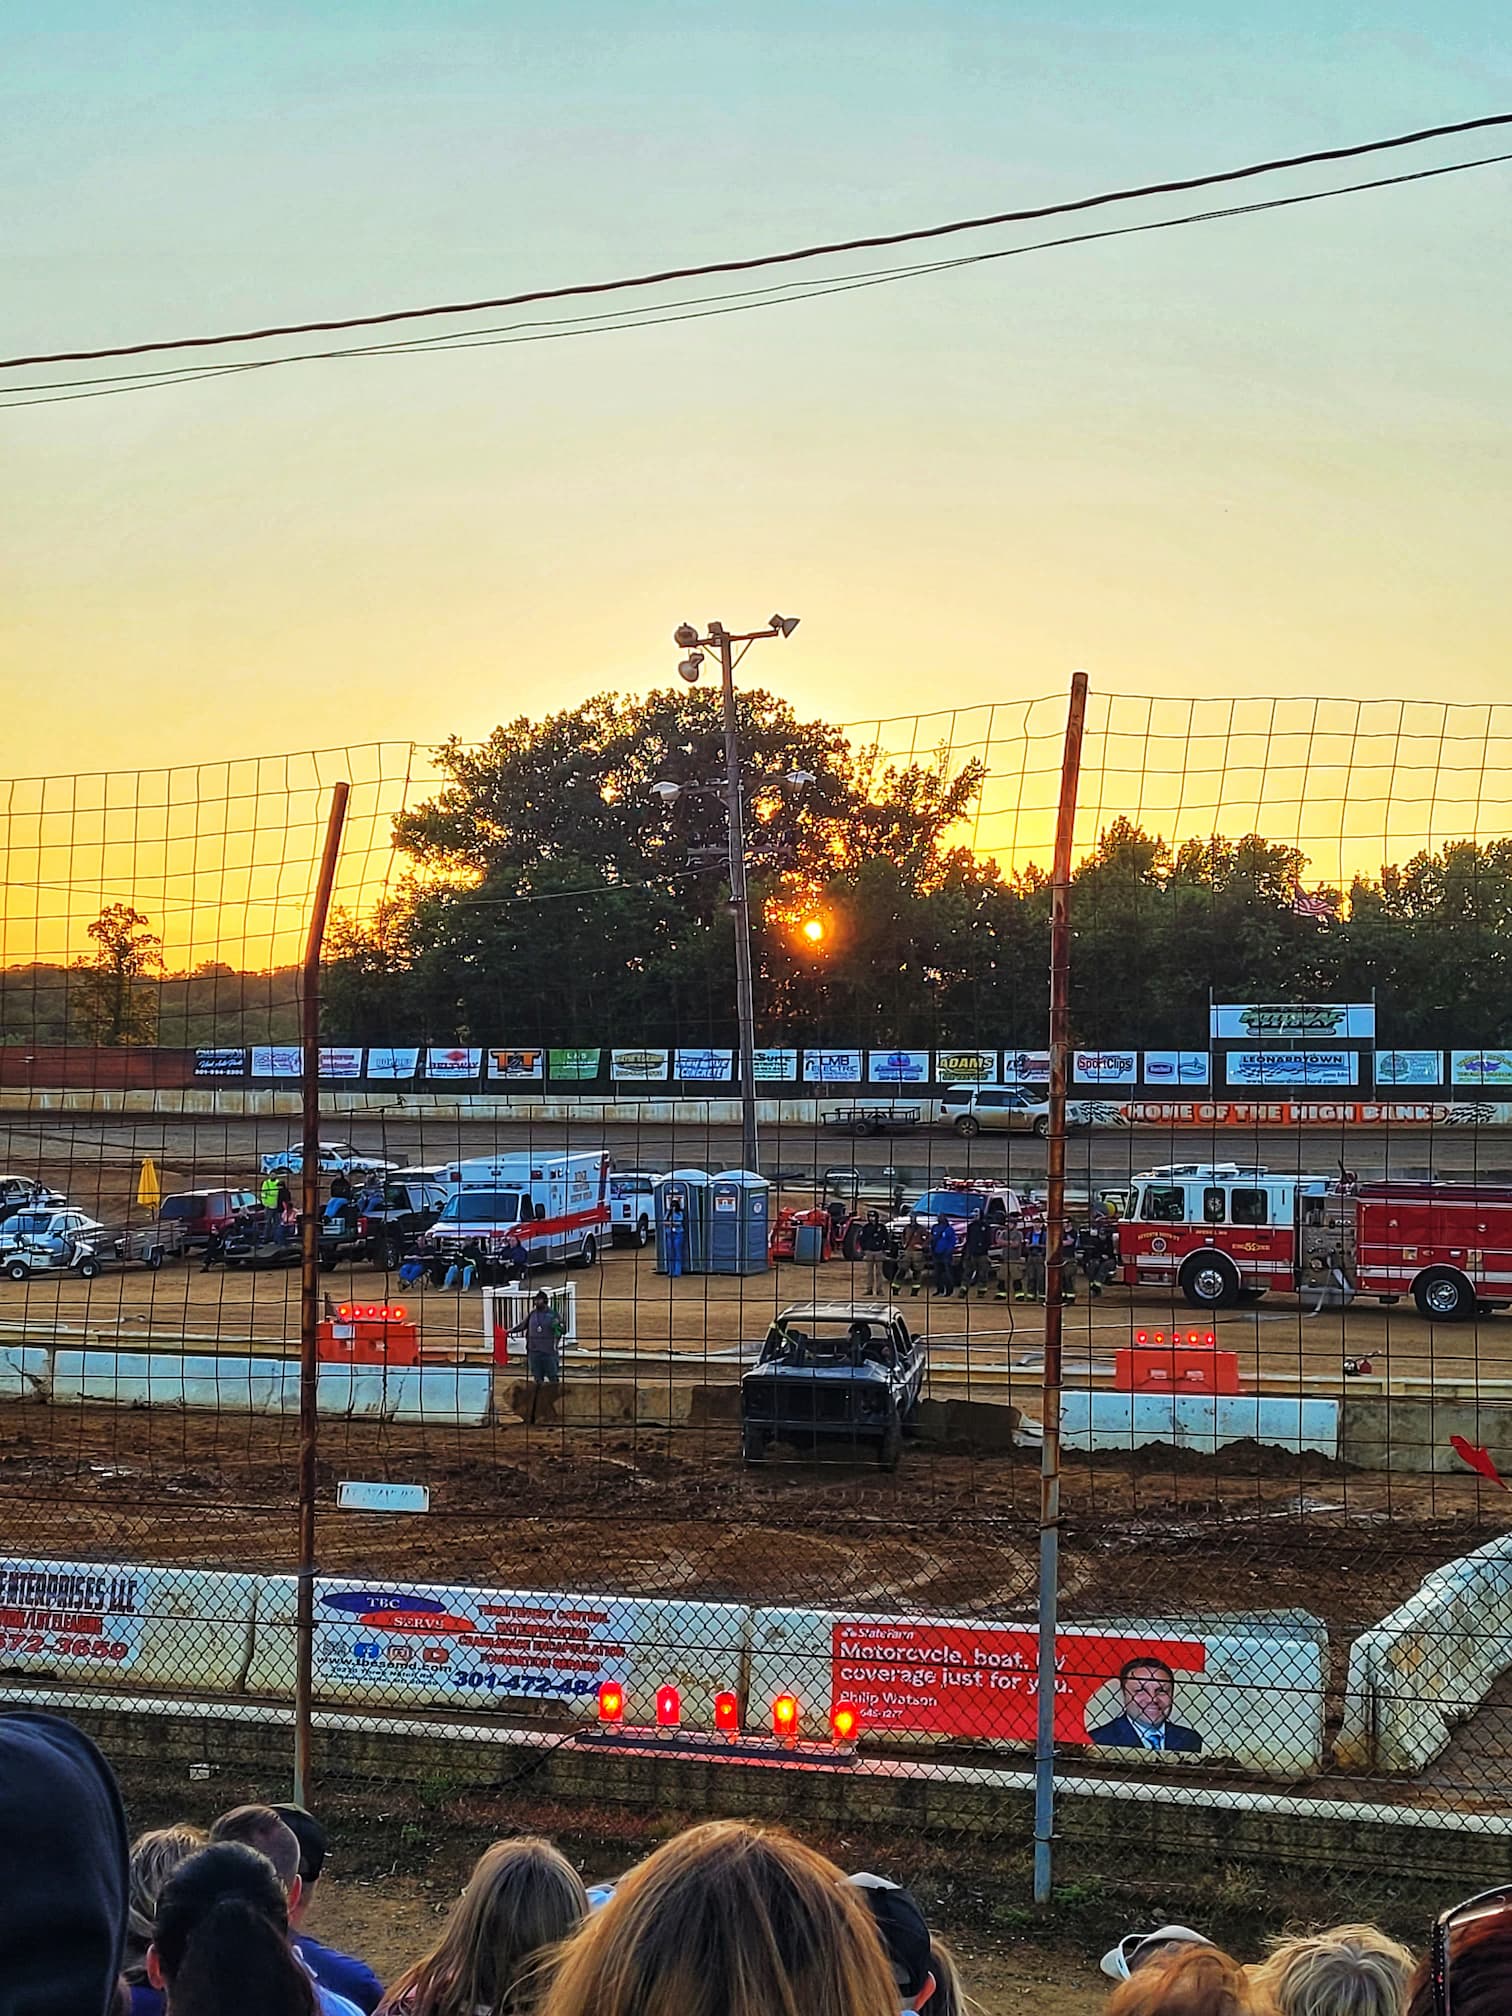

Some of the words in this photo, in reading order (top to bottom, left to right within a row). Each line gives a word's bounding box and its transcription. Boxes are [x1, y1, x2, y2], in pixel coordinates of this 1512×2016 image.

[939, 1056, 994, 1069] ADAMS
[1242, 1055, 1343, 1064] LEONARDTOWN
[1127, 1103, 1194, 1122] HOME
[1200, 1103, 1230, 1122] OF
[1234, 1103, 1282, 1123] THE
[1290, 1103, 1354, 1122] HIGH
[1362, 1103, 1449, 1124] BANKS
[0, 1571, 106, 1611] ENTERPRISES
[108, 1577, 138, 1613] LLC
[366, 1596, 401, 1610] TBC
[840, 1641, 968, 1667] Motorcycle,
[974, 1648, 1029, 1671] boat,
[840, 1667, 937, 1688] coverage
[939, 1667, 983, 1689] just
[990, 1671, 1022, 1690] for
[1026, 1678, 1074, 1696] yu.
[840, 1690, 880, 1707] Philip
[882, 1691, 938, 1707] Watson
